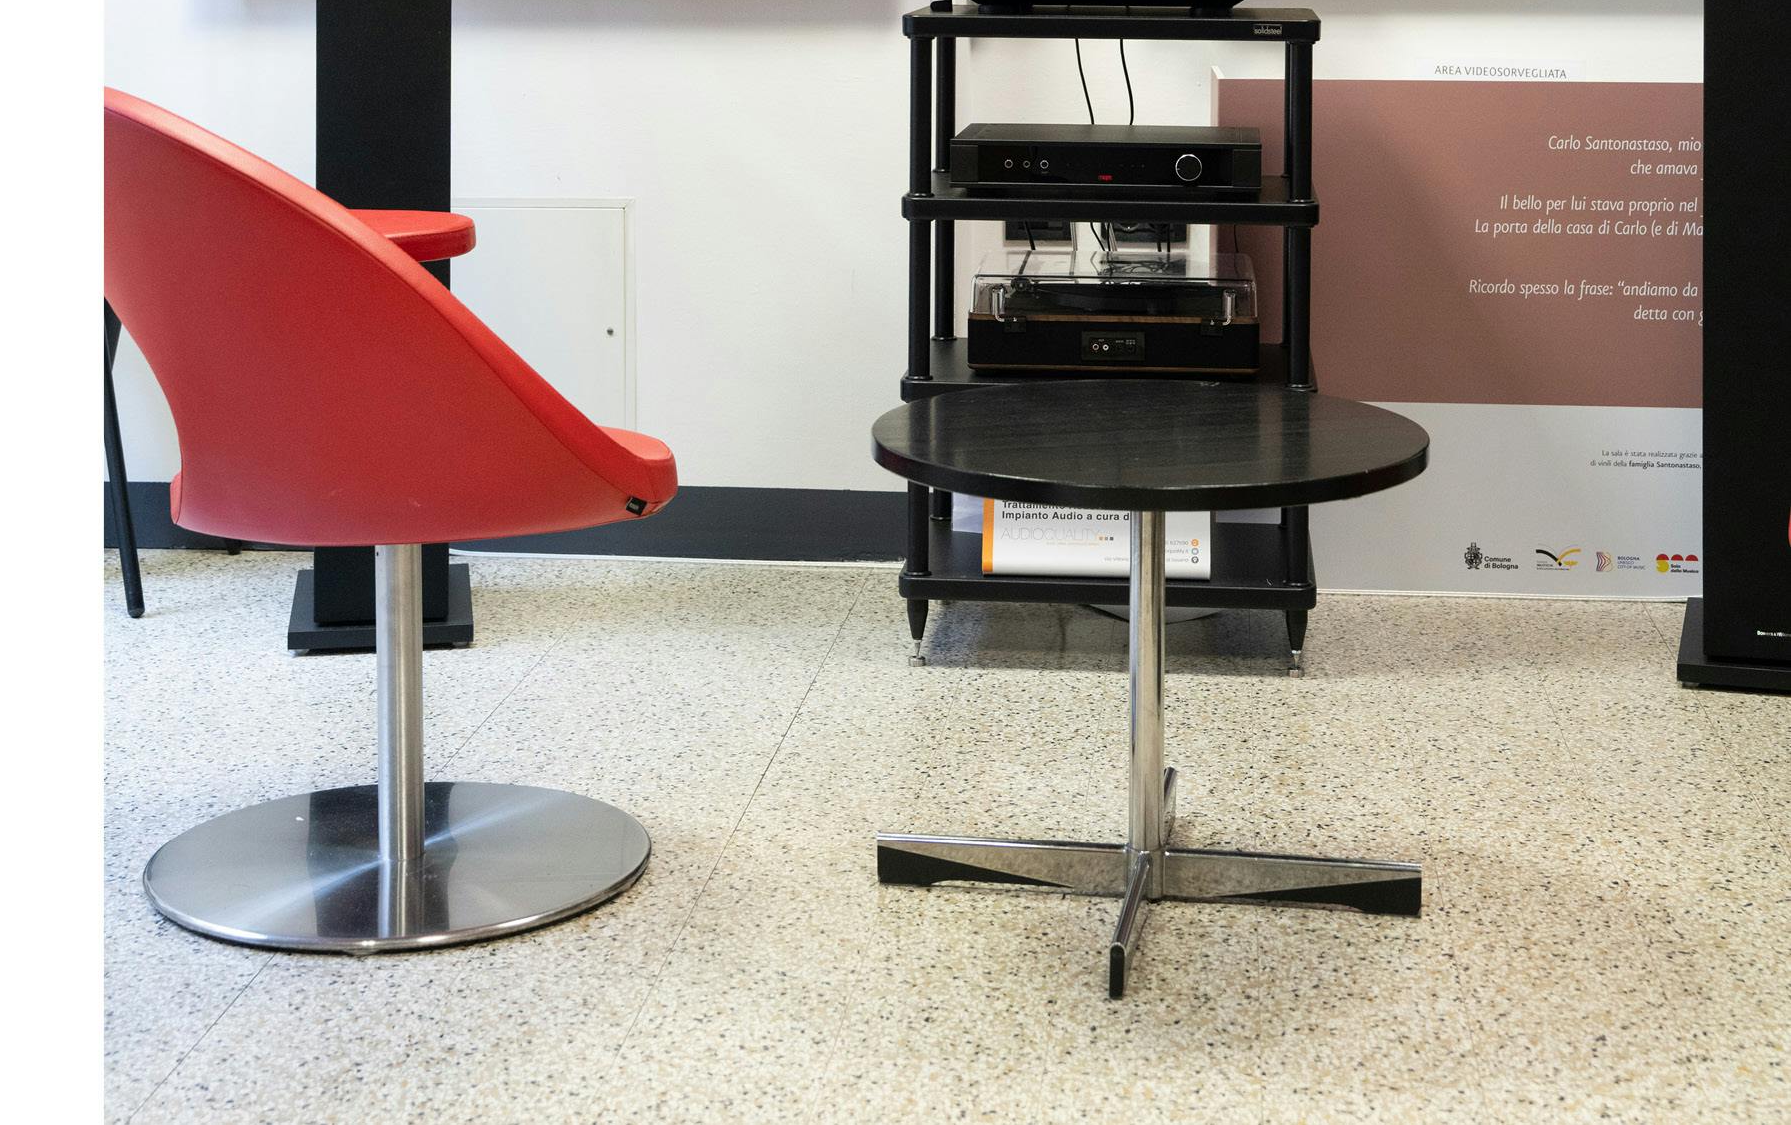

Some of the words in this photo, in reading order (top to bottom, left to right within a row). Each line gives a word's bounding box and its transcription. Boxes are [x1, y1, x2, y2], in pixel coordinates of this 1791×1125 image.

[1253, 25, 1282, 35] solidsteel
[1435, 66, 1461, 75] AREA
[1465, 67, 1567, 79] VIDEOSORVEGLIATA
[1549, 135, 1581, 150] Carlo
[1585, 136, 1673, 153] Santonastaso,
[1678, 138, 1701, 151] mio
[1630, 160, 1651, 175] che
[1656, 164, 1698, 175] amava
[1500, 195, 1507, 209] Il
[1513, 196, 1542, 210] bello
[1546, 199, 1566, 214] per
[1571, 197, 1586, 211] lui
[1590, 200, 1624, 211] stava
[1629, 199, 1674, 216] proprio
[1679, 198, 1698, 212] nel
[1475, 219, 1489, 233] La
[1494, 222, 1527, 237] porta
[1532, 220, 1561, 234] della
[1566, 223, 1593, 235] casa
[1598, 220, 1610, 235] di
[1614, 221, 1647, 236] Carlo
[1651, 220, 1662, 238] (e
[1666, 221, 1678, 236] di
[1469, 279, 1515, 294] Ricordo
[1519, 282, 1559, 298] spesso
[1564, 280, 1574, 295] la
[1578, 280, 1613, 300] frase:
[1682, 282, 1698, 297] da
[1634, 305, 1667, 320] detta
[1672, 309, 1694, 321] con
[1002, 511, 1049, 521] Impianto
[1052, 512, 1083, 520] Audio
[1096, 513, 1120, 521] cura
